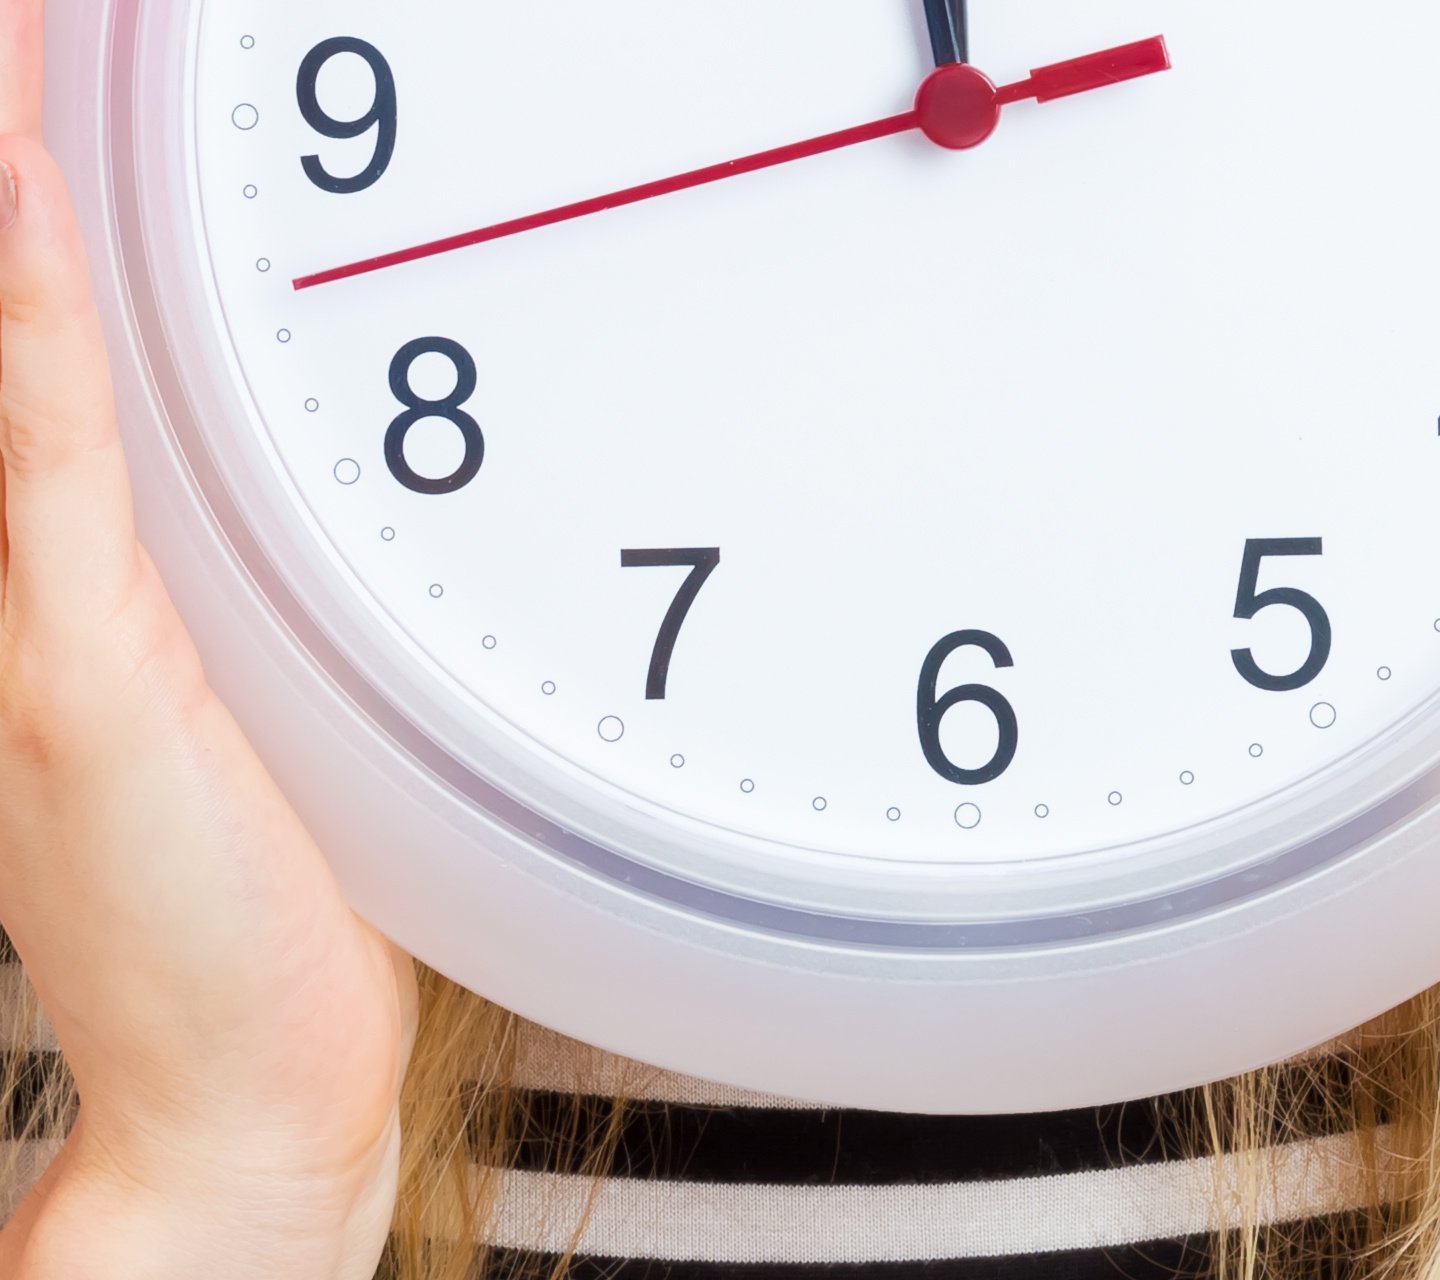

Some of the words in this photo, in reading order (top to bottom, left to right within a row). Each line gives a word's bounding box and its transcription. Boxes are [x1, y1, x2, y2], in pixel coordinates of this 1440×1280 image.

[296, 37, 397, 194] 9
[384, 337, 484, 494] 8
[621, 547, 719, 699] 7
[1231, 537, 1331, 691] 5
[917, 630, 1018, 785] 6
